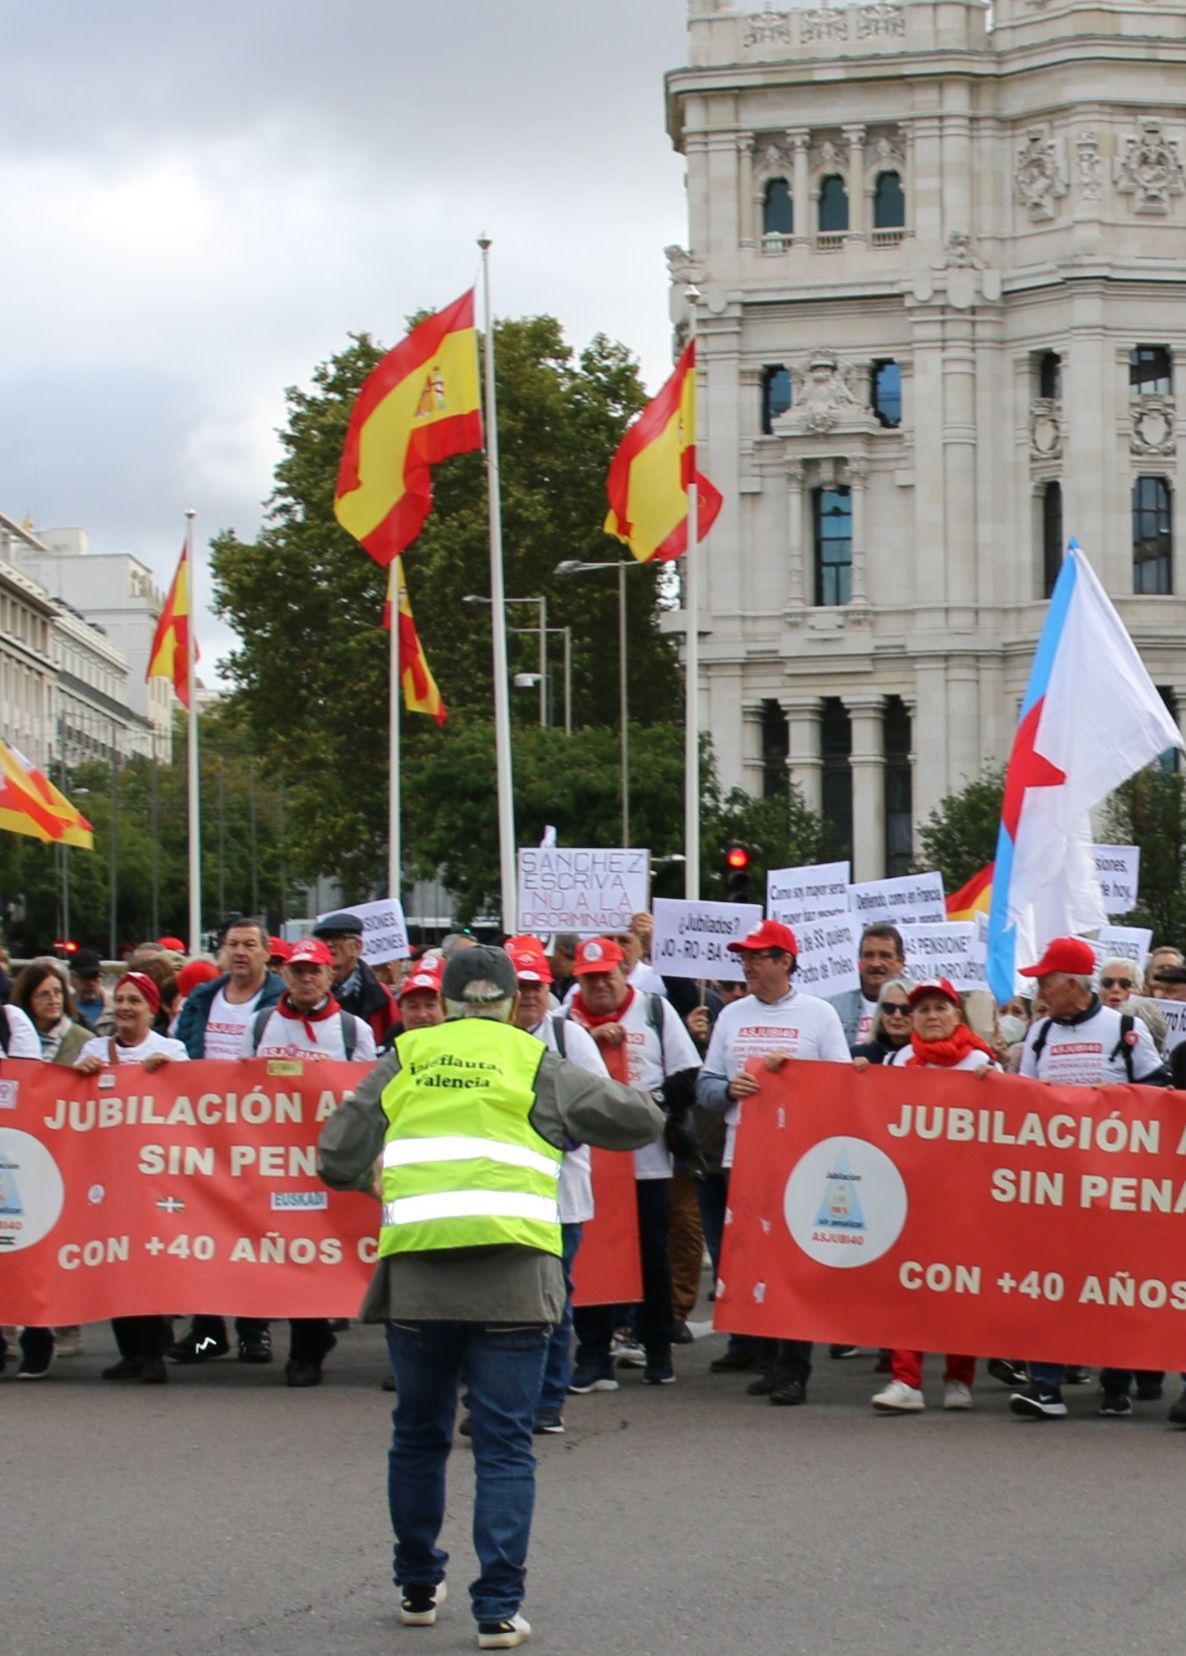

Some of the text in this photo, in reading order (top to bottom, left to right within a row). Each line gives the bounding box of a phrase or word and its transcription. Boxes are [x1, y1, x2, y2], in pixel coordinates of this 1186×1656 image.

[521, 852, 643, 873] SANCHEZ
[524, 873, 624, 891] ESCRIVA
[532, 891, 564, 911] NO
[44, 1085, 302, 1132] JUBILACIÓN
[887, 1104, 1159, 1154] JUBILACIÓN
[138, 1143, 214, 1176] SIN
[273, 1192, 327, 1208] EUSKADI
[991, 1168, 1064, 1206] SIN
[57, 1236, 129, 1270] CON
[145, 1234, 215, 1261] +40
[229, 1231, 343, 1264] AÑOS
[812, 1232, 864, 1246] ASJUBI40
[899, 1261, 981, 1295] CON
[997, 1271, 1065, 1301] +40
